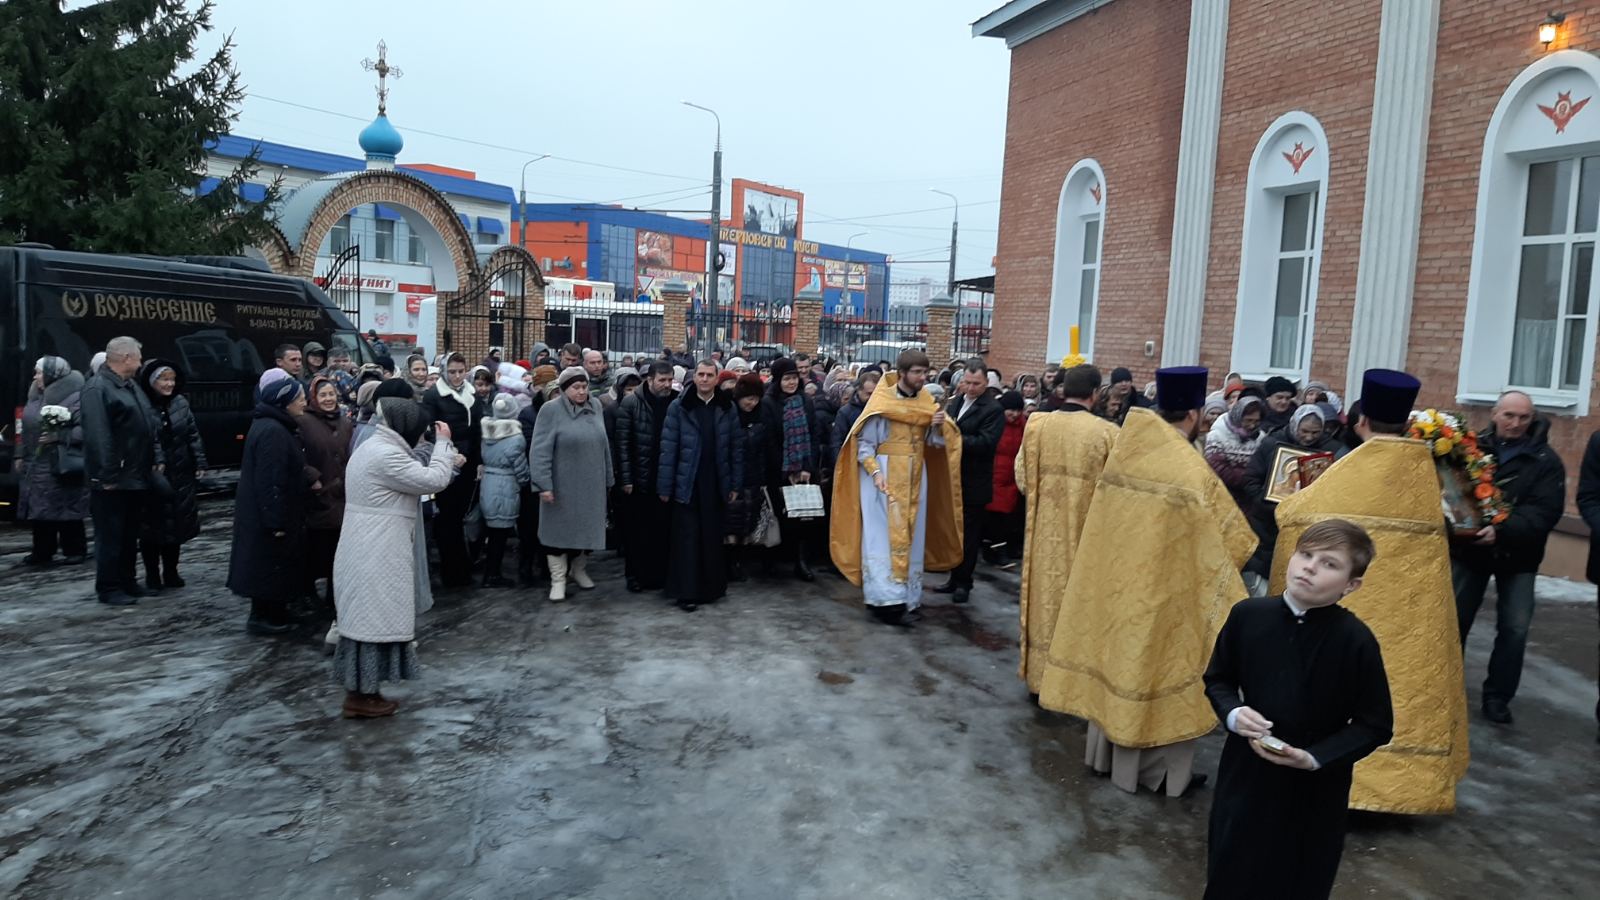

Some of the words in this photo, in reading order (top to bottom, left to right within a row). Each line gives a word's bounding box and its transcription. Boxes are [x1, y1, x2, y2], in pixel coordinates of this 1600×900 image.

[337, 275, 392, 288] МАГНИТ
[94, 292, 217, 324] ВОЗНЕСЕНИЕ
[236, 304, 290, 317] РИТУАЛЬНАЯ
[291, 308, 321, 319] СЛУЖБА
